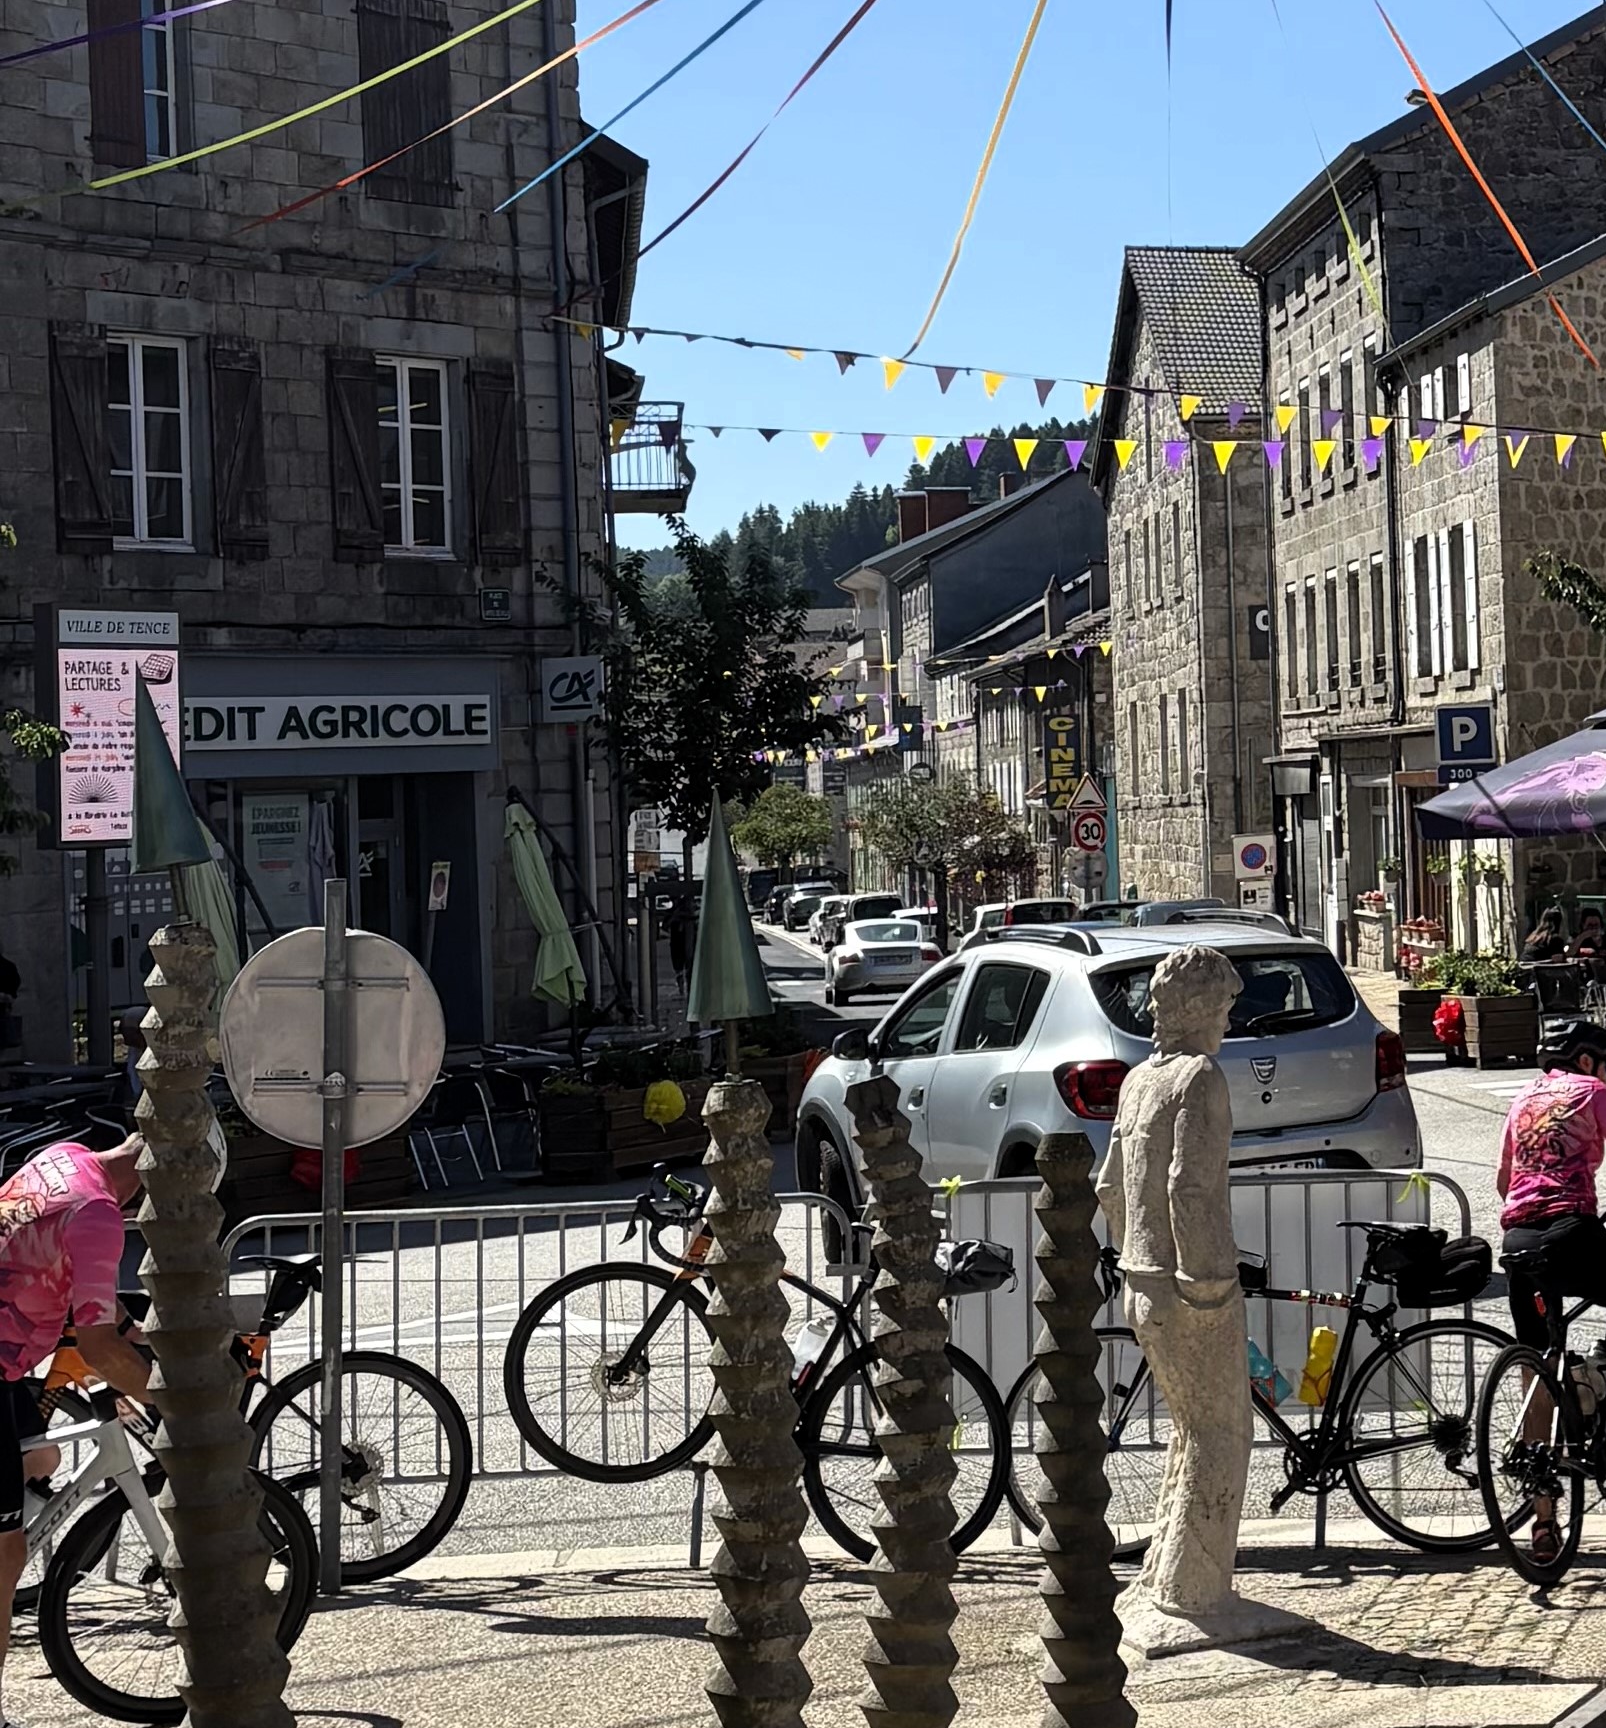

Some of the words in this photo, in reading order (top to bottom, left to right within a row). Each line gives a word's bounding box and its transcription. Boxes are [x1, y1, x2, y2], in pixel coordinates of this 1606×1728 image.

[67, 620, 102, 633] VILLE
[106, 621, 125, 634] DE
[129, 622, 171, 634] TENCE
[64, 661, 113, 675] PARTAGE
[120, 661, 129, 675] &
[65, 677, 121, 691] LECTURES
[276, 703, 488, 740] AGRICOLE
[1452, 717, 1477, 751] P
[1049, 717, 1078, 807] CINEMA
[1081, 823, 1101, 841] 30
